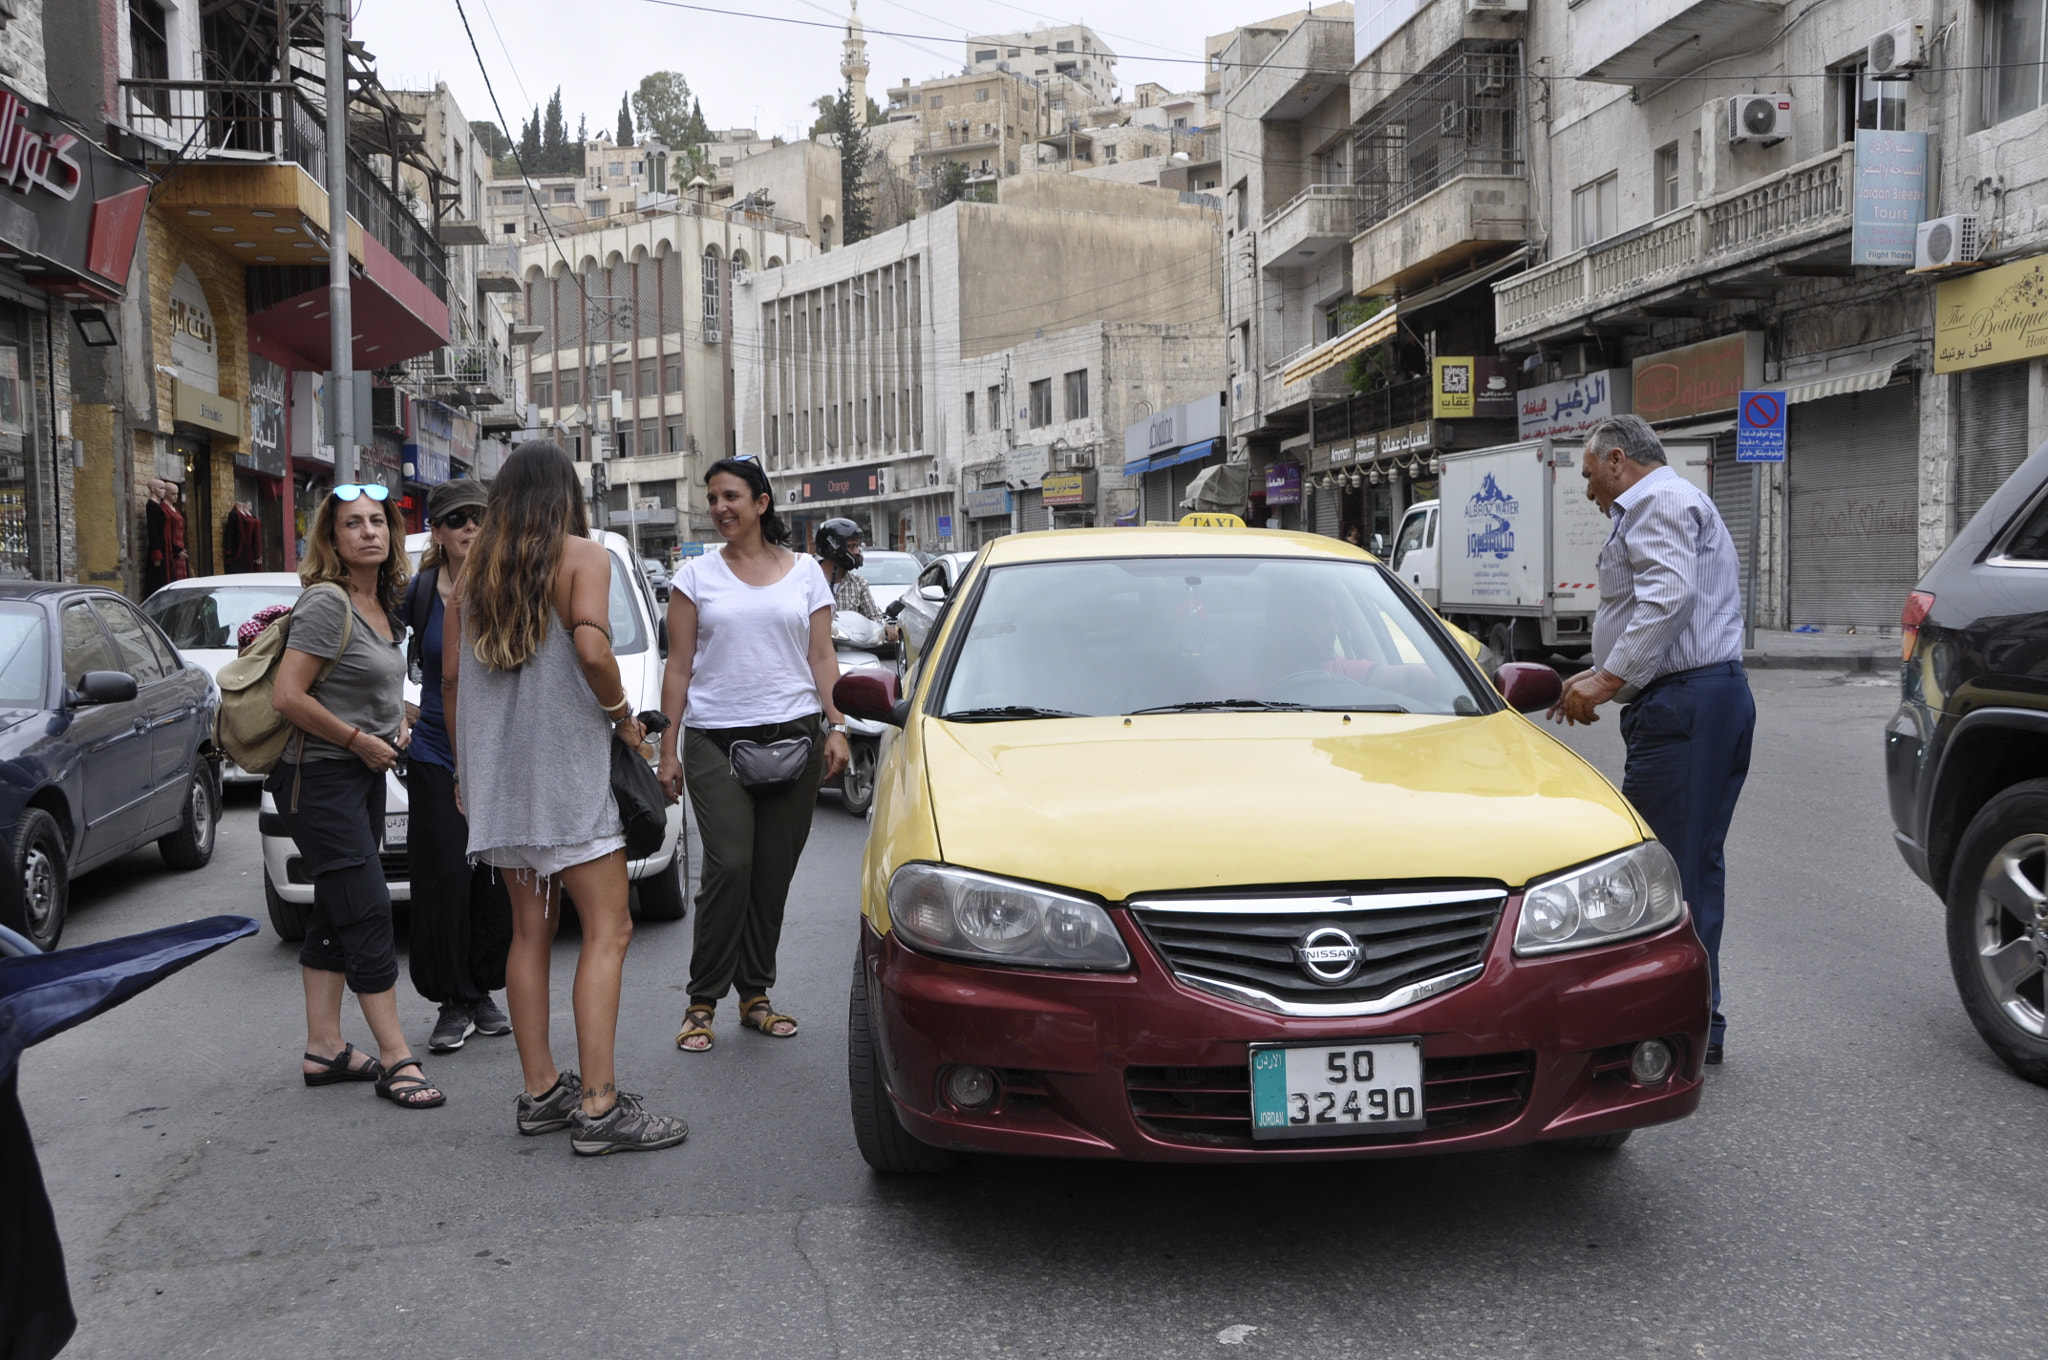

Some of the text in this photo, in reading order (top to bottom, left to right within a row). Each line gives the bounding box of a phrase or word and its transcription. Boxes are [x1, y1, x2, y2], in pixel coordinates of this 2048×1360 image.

[1890, 161, 1923, 178] للسياحة
[1858, 187, 1924, 201] Jordan Breeze
[1873, 206, 1909, 220] Tours
[1868, 250, 1912, 260] Flight Ticets
[1942, 304, 2048, 340] The Boutique
[2025, 334, 2048, 349] Hote
[1939, 338, 1993, 362] فندق بوتيك
[1550, 375, 1605, 422] الزغير
[1769, 431, 1782, 439] يمنع
[827, 480, 850, 494] Orange
[1495, 501, 1520, 515] WATER
[1189, 516, 1235, 527] TAXI
[387, 835, 407, 843] JORDA
[1306, 949, 1357, 959] NISSAN
[1256, 1053, 1283, 1070] الاردن
[1327, 1050, 1375, 1084] 50
[1289, 1086, 1415, 1125] 32490
[1258, 1111, 1284, 1127] JORDAN
